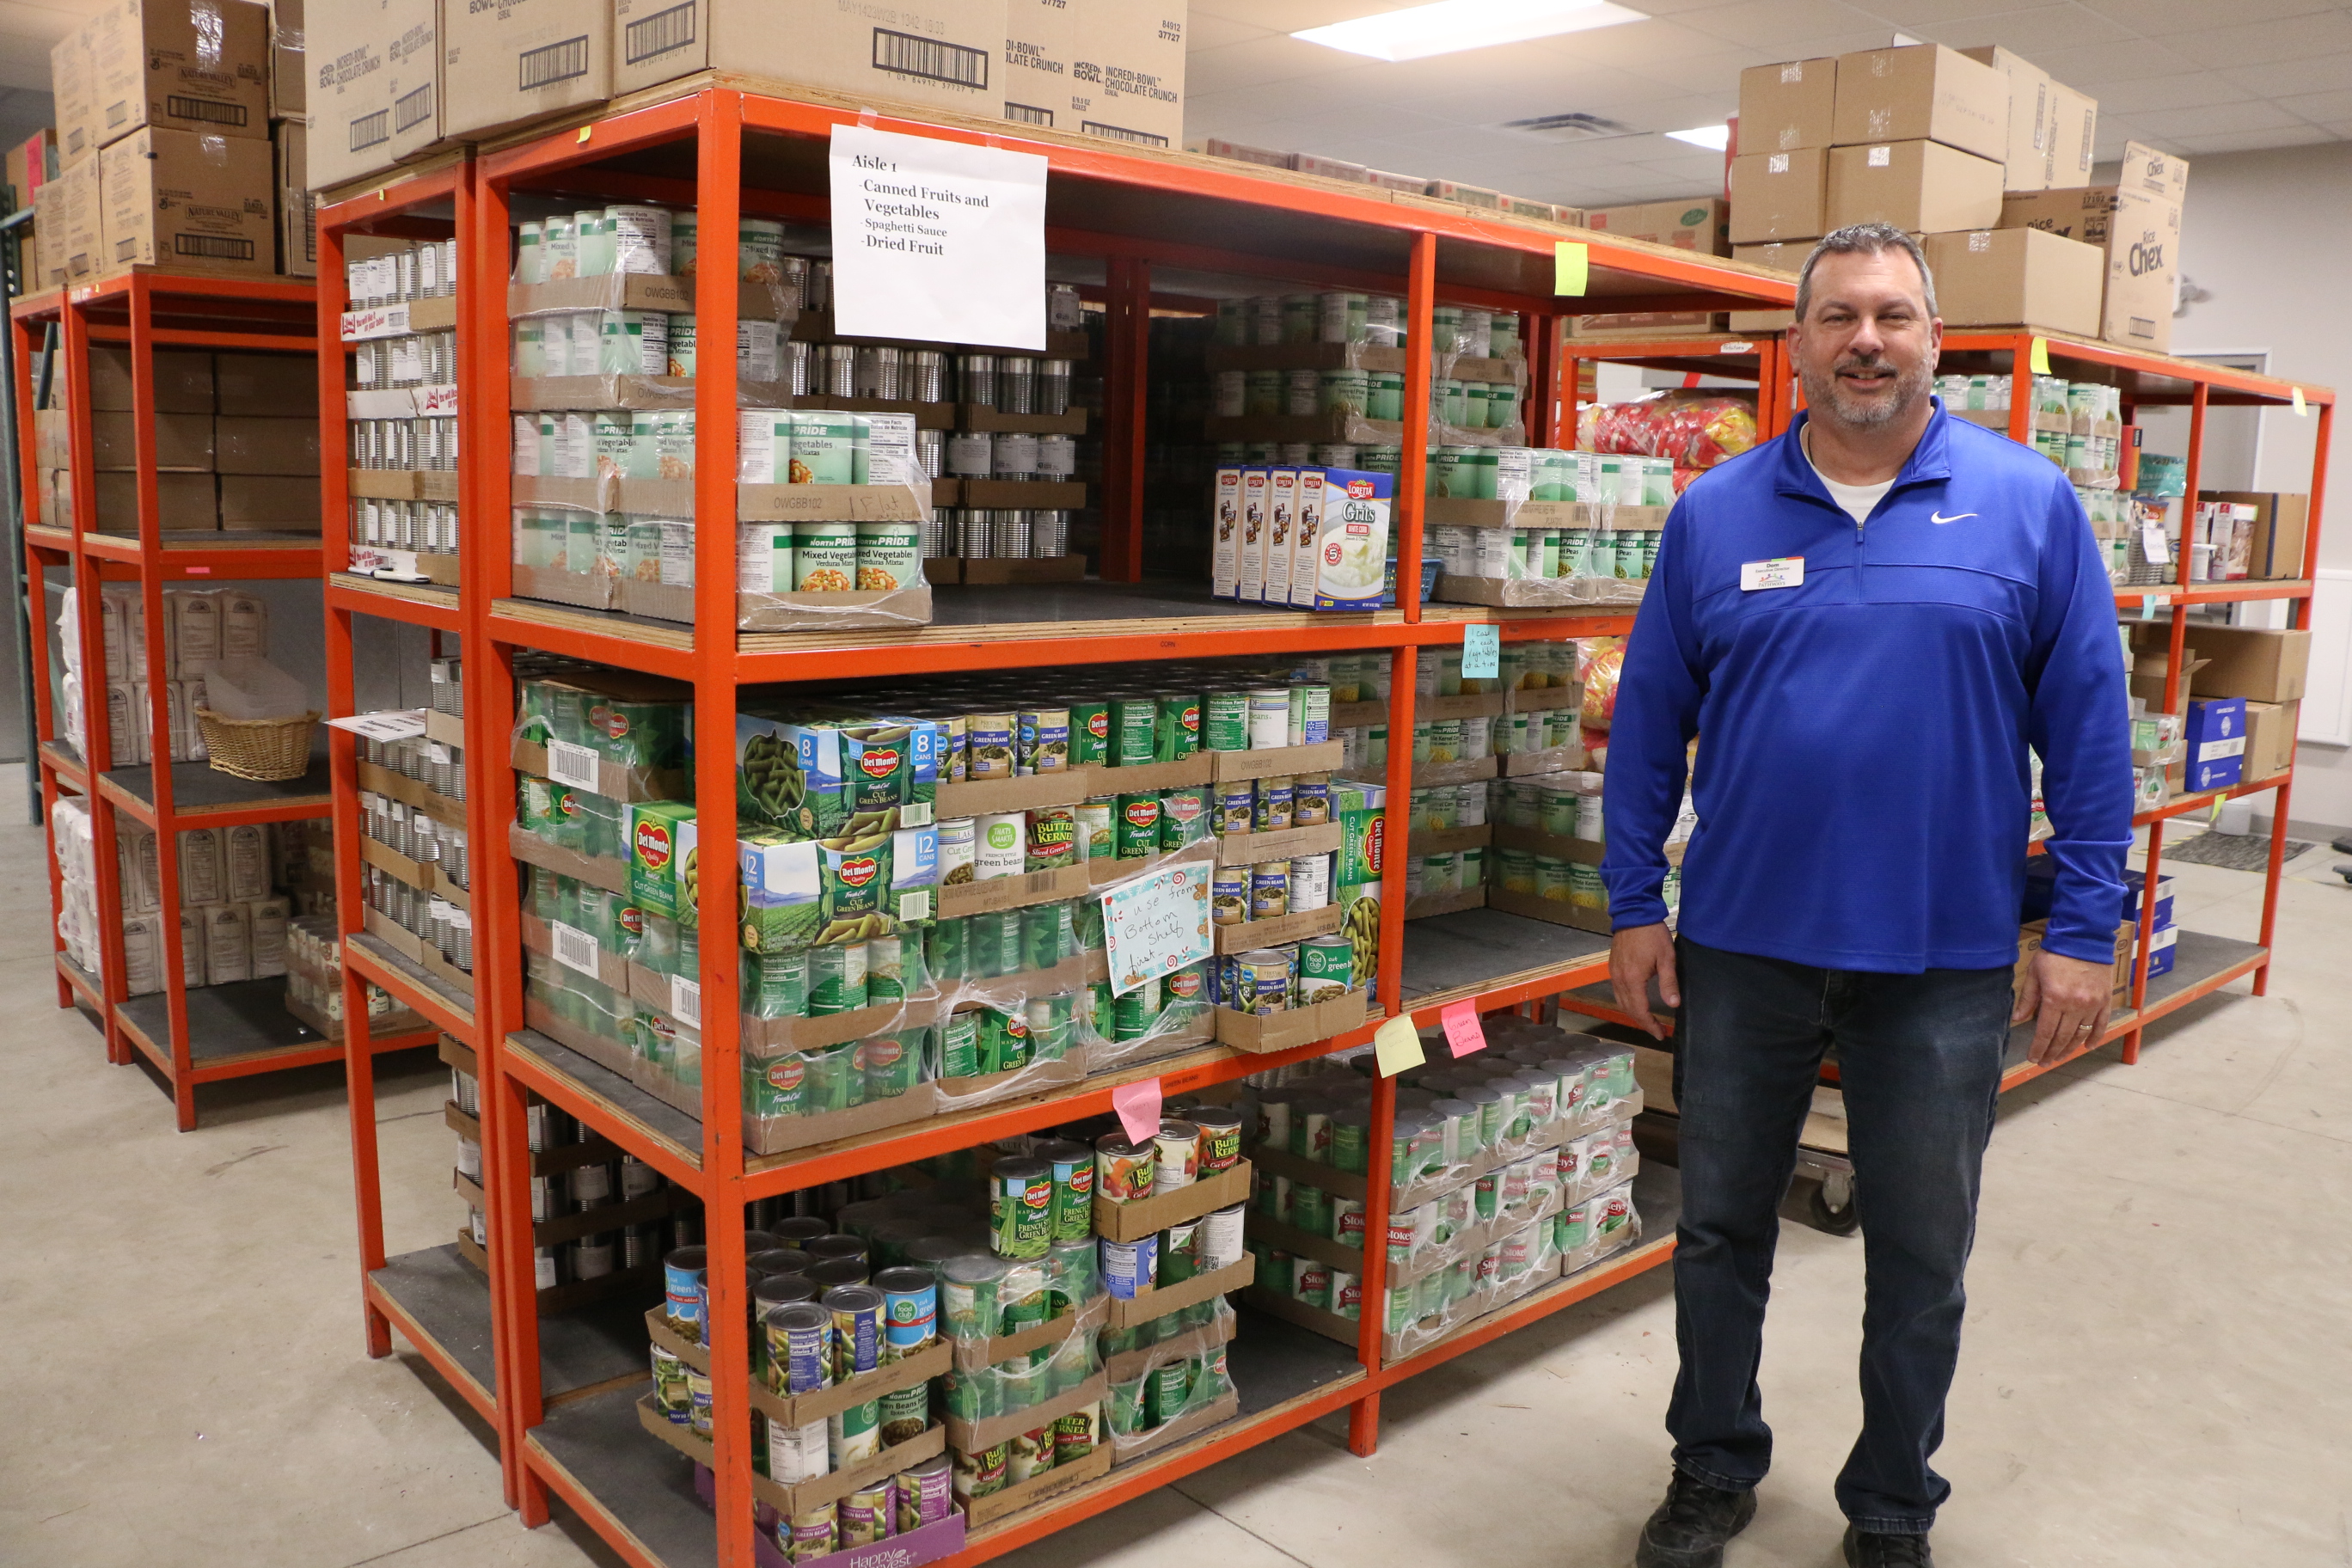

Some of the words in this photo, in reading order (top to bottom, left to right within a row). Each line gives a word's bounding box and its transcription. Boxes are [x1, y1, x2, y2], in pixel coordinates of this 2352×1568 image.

[1162, 20, 1181, 32] 84912
[1158, 30, 1180, 42] 37727
[1031, 57, 1063, 75] CRUNCH
[1074, 70, 1101, 83] BOWL
[912, 77, 936, 87] 84912
[942, 82, 965, 92] 37727
[1105, 77, 1147, 97] CHOCOLATE
[1148, 89, 1178, 103] CRUNCH
[1072, 103, 1087, 112] BOXES
[852, 155, 887, 171] Aisle
[891, 162, 897, 172] 1
[2147, 161, 2165, 177] Chex
[921, 187, 961, 204] Fruits
[965, 195, 989, 207] and
[188, 206, 216, 217] NATURE
[216, 208, 240, 222] VALLEY
[864, 198, 940, 220] Vegetables
[917, 224, 947, 237] Sauce
[2143, 229, 2156, 245] Rice
[909, 240, 944, 255] Fruit
[2129, 242, 2165, 277] Chex
[793, 426, 827, 436] PRIDE
[1348, 486, 1374, 496] LORETTA
[775, 497, 822, 509] OWGBB102
[861, 494, 898, 512] Flat
[1342, 501, 1375, 523] Grits
[810, 537, 834, 547] NORTH
[835, 537, 856, 547] PRIDE
[878, 536, 910, 546] PRIDE
[1561, 538, 1584, 547] PRIDE
[873, 550, 913, 560] Vegetables
[802, 738, 811, 757] 8
[916, 734, 929, 753] 8
[800, 757, 813, 766] CANS
[863, 757, 875, 767] Del
[876, 756, 897, 766] Monte
[879, 793, 897, 803] BEANS
[1375, 821, 1383, 834] Del
[638, 832, 648, 848] Del
[648, 836, 669, 854] Monte
[919, 836, 934, 854] 12
[947, 847, 961, 855] Cut
[1032, 848, 1048, 856] Sliced
[1049, 846, 1064, 854] Green
[1373, 835, 1383, 869] Monte
[745, 854, 757, 875] 12
[975, 859, 1001, 867] green
[842, 867, 854, 877] Del
[854, 864, 875, 874] Monte
[745, 874, 758, 884] CANS
[1134, 897, 1159, 916] use
[1168, 884, 1198, 899] from
[836, 904, 856, 913] GREEN
[856, 901, 874, 910] BEANS
[1124, 911, 1178, 940] Bottom
[1317, 923, 1336, 932] USDA
[1328, 962, 1348, 971] green
[1453, 1031, 1479, 1047] Beans
[784, 1068, 804, 1078] Monte
[882, 1087, 905, 1096] BEANS
[781, 1103, 796, 1112] CUT
[1064, 1207, 1084, 1216] FRENCH
[1064, 1214, 1084, 1222] GREEN
[1019, 1222, 1043, 1232] FRENCH
[1020, 1230, 1041, 1240] GREEN
[670, 1283, 692, 1294] green
[889, 1392, 910, 1400] NORTH
[895, 1399, 917, 1410] Beans
[812, 1527, 830, 1535] BEANS
[850, 1548, 896, 1568] Happy
